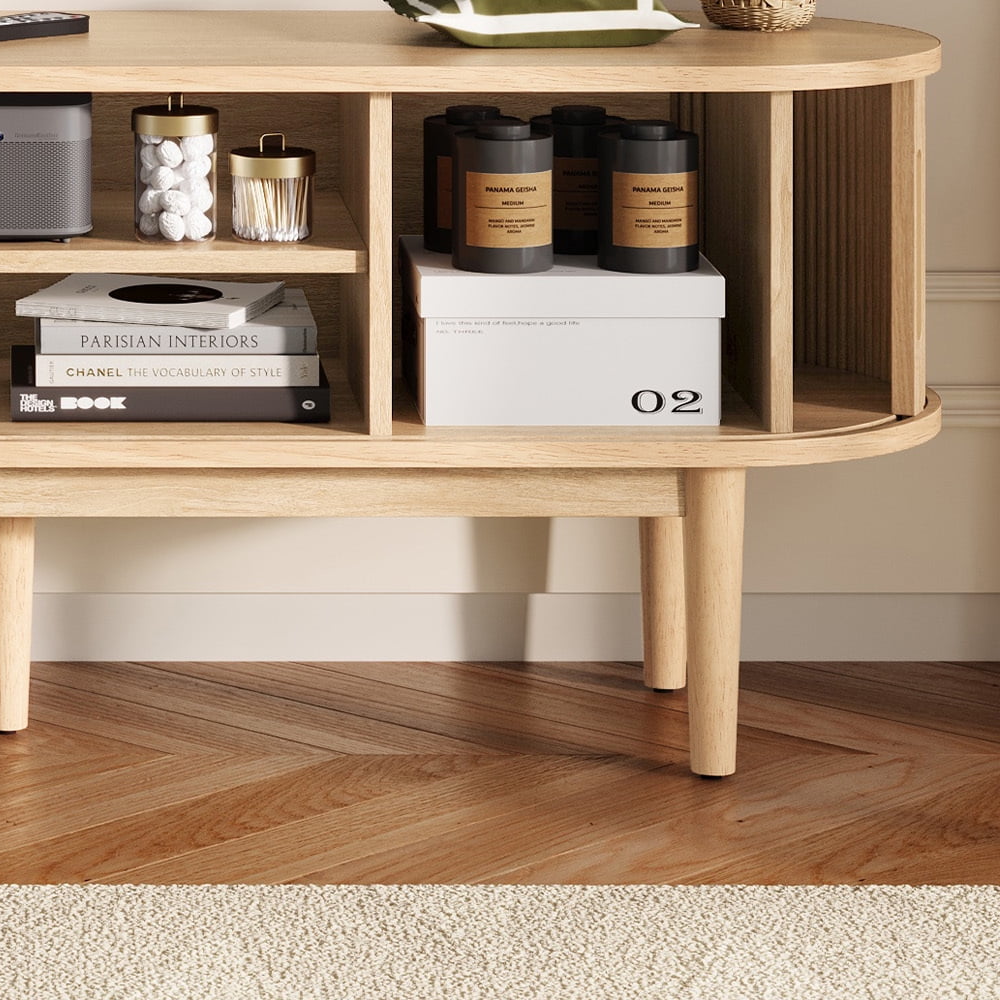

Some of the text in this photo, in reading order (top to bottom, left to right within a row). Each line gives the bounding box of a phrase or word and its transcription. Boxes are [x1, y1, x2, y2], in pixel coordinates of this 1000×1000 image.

[81, 335, 258, 348] PARISIAN INTERIORS
[66, 367, 282, 377] CHANEL THE VOCABULARY OF STYLE
[60, 397, 127, 409] BOOK
[631, 389, 704, 414] 02
